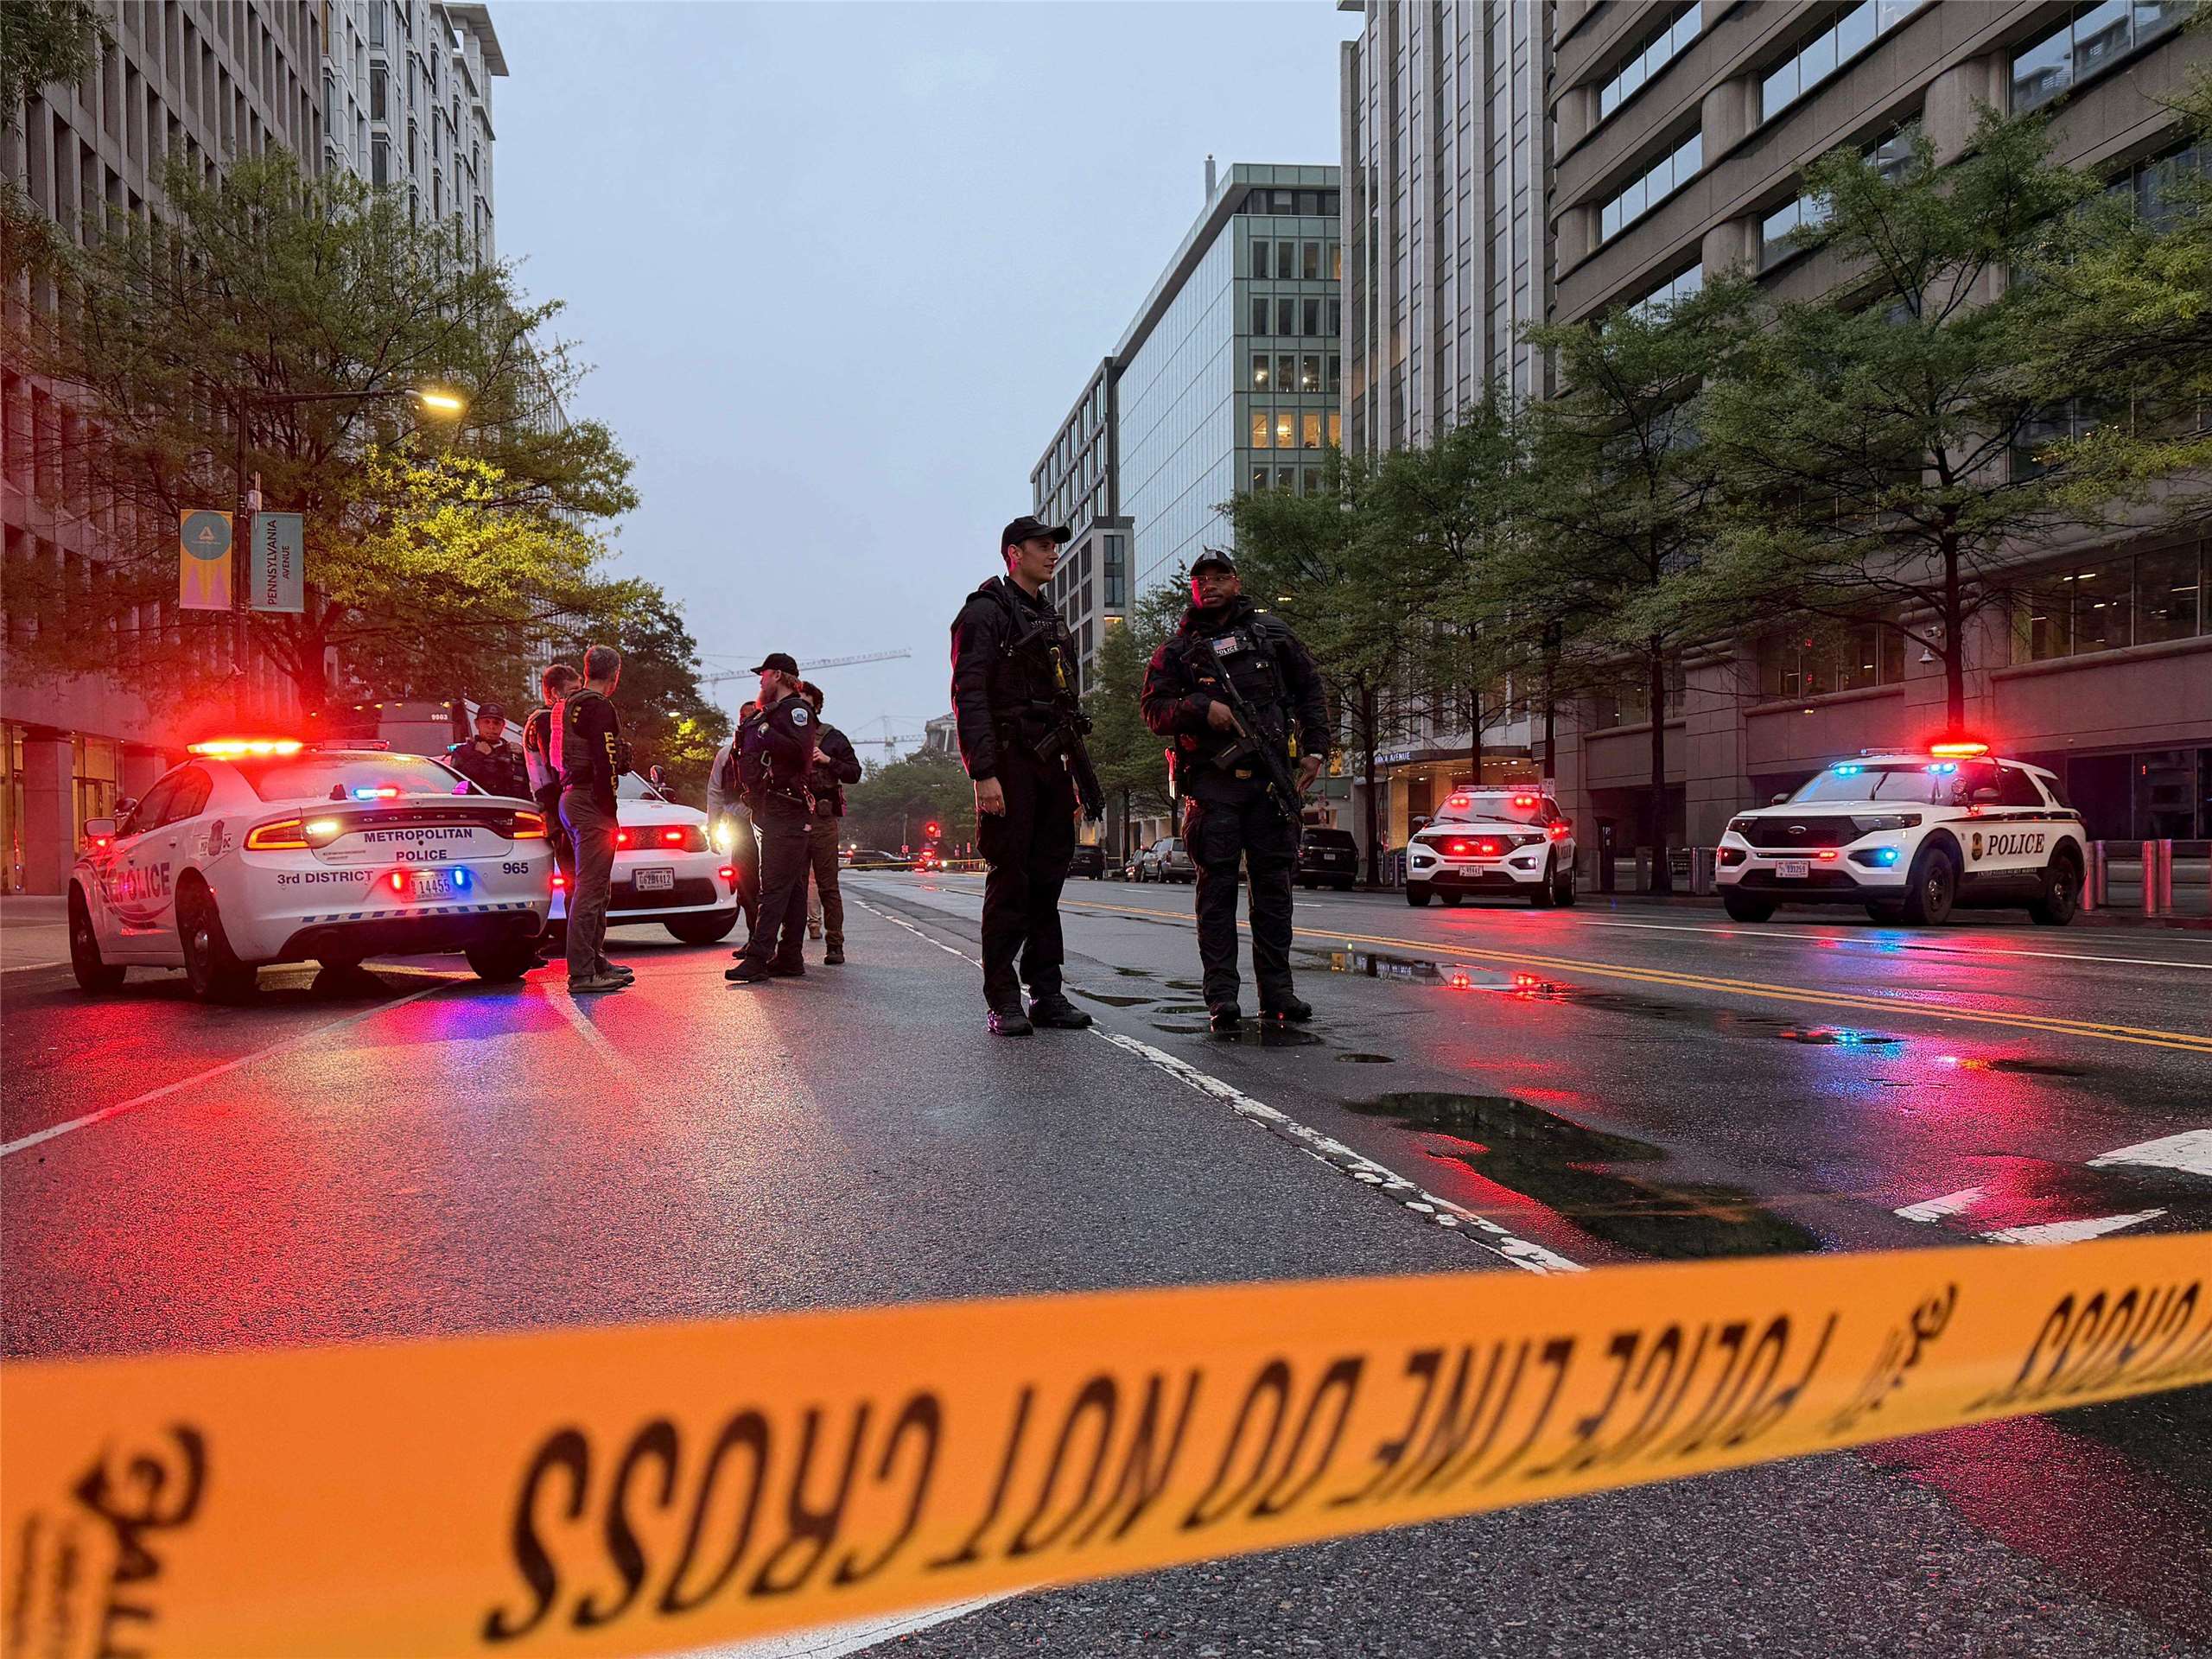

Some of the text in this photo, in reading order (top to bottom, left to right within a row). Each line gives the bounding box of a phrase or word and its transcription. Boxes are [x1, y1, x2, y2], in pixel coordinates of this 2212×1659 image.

[267, 520, 277, 606] PENNSYLVANIA
[282, 545, 290, 579] AVENUE
[364, 828, 474, 842] METROPOLITAN
[1986, 834, 2045, 855] POLICE
[396, 849, 448, 861] POLICE
[502, 862, 529, 875] 965
[277, 870, 374, 885] 3rd DISTRICT
[419, 879, 450, 894] 14455
[1528, 1311, 1840, 1476] POLICE
[1326, 1336, 1577, 1510] LINE
[1179, 1354, 1366, 1531] DO
[925, 1367, 1204, 1573] NOT
[481, 1390, 944, 1643] CROSS
